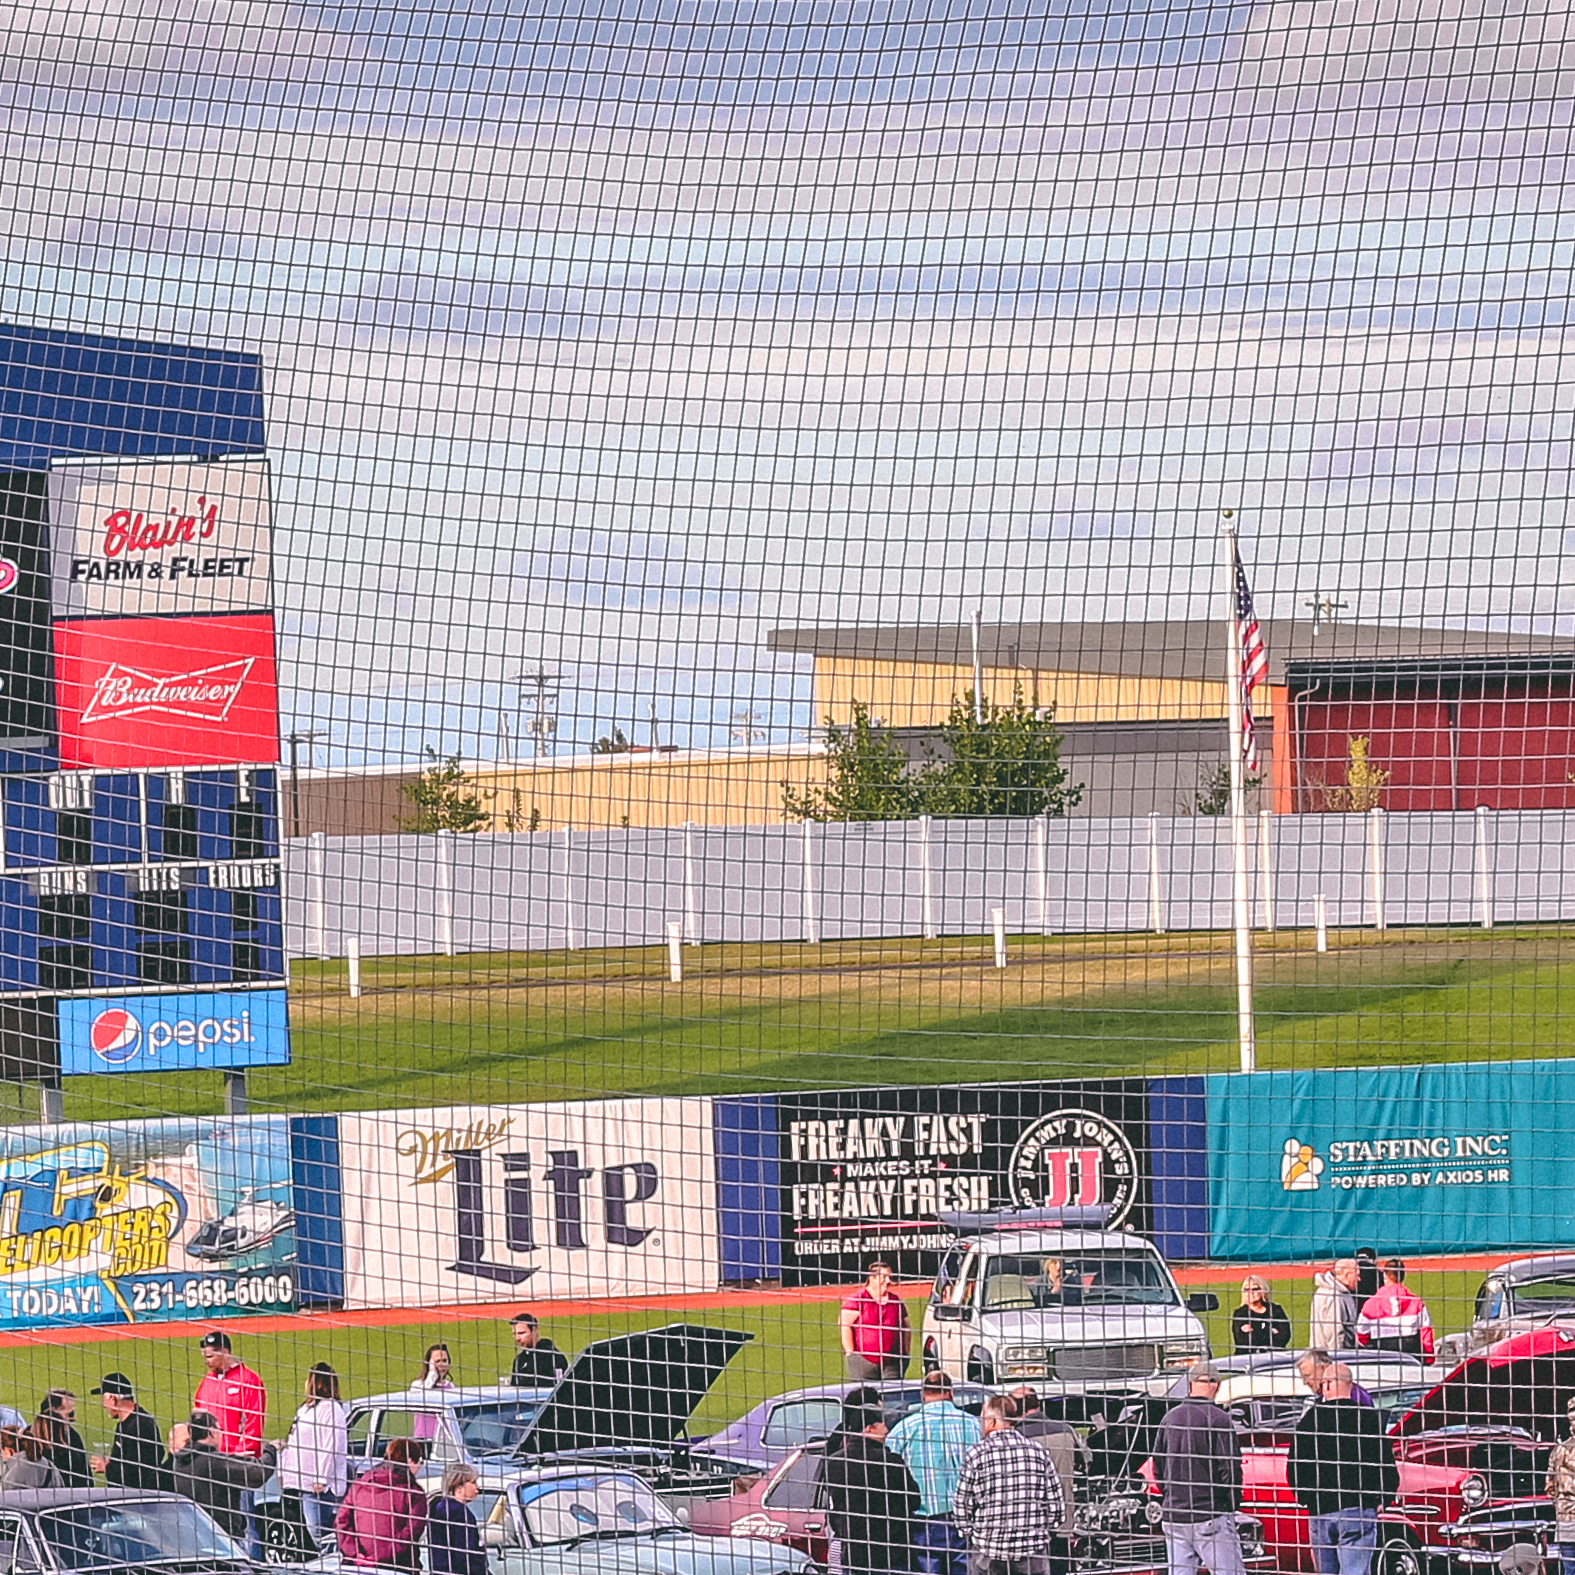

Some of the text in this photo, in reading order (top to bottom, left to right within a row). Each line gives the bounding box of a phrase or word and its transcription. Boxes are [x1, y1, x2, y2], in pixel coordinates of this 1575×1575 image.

[104, 496, 218, 557] Blain's
[70, 555, 251, 582] FARM & FLEET
[94, 676, 239, 707] Budweiser
[47, 775, 94, 810] OUT
[169, 772, 184, 804] H
[239, 768, 251, 803] E
[40, 870, 88, 896] RUNS
[138, 867, 180, 891] HITS
[207, 865, 276, 888] ERRORS
[148, 1010, 251, 1055] pepsi
[395, 1116, 516, 1180] Miller
[790, 1115, 987, 1162] FREAKY FAST
[1017, 1119, 1130, 1180] JIMMY JOHN'S
[1328, 1136, 1451, 1163] STAFFING
[847, 1159, 933, 1178] MAKES IT
[1330, 1167, 1510, 1191] POWERED BY AXIOS HR
[793, 1178, 897, 1221] FREAKY
[903, 1176, 989, 1214] FRESH
[442, 1149, 658, 1285] Lite
[794, 1239, 840, 1256] ORDER
[843, 1237, 861, 1253] AT
[6, 1285, 102, 1317] TODAY!
[131, 1274, 293, 1312] 231-668-6000
